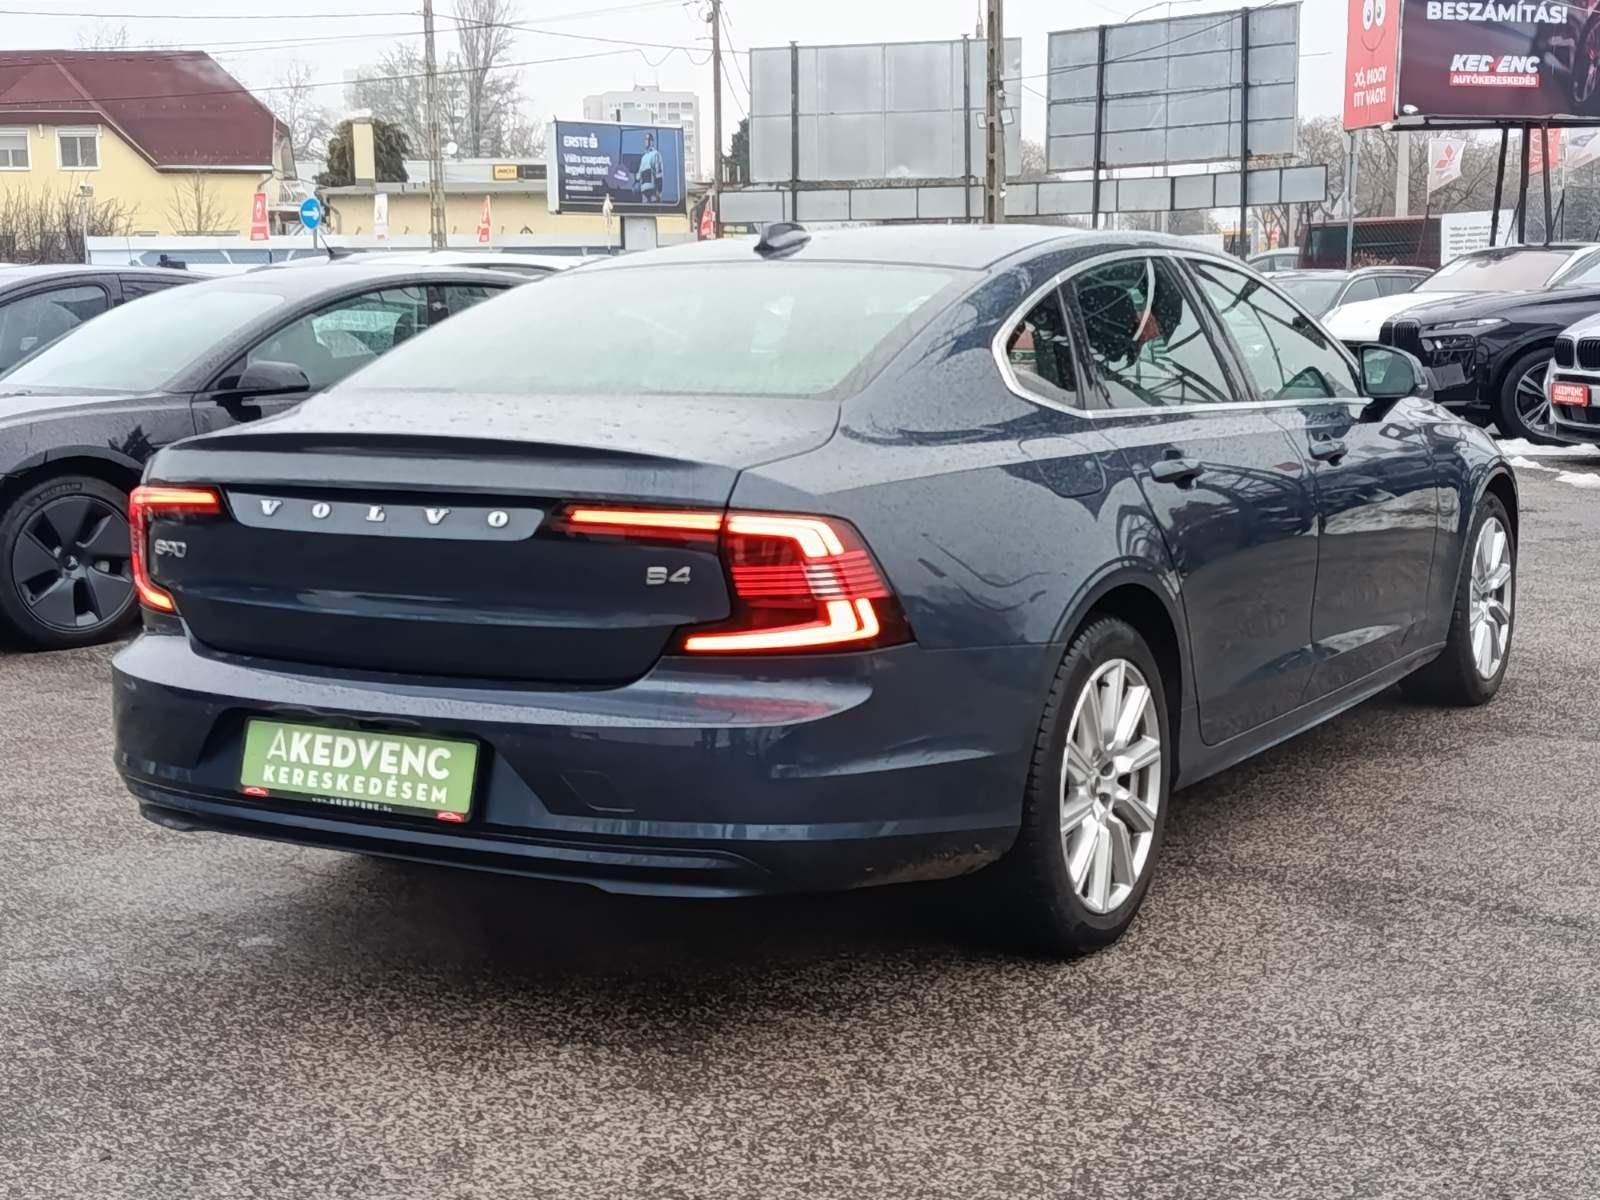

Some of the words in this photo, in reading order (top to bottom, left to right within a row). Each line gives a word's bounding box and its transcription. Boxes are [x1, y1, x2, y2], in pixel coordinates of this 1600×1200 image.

[1426, 0, 1568, 24] BESZÁMÍTÁS!
[1366, 65, 1388, 85] HOGY
[1452, 74, 1537, 86] AUTÓKERESKEDÉS
[259, 499, 510, 528] VOLVO
[646, 566, 691, 585] B4
[263, 764, 448, 805] KERESKEDÉSEM
